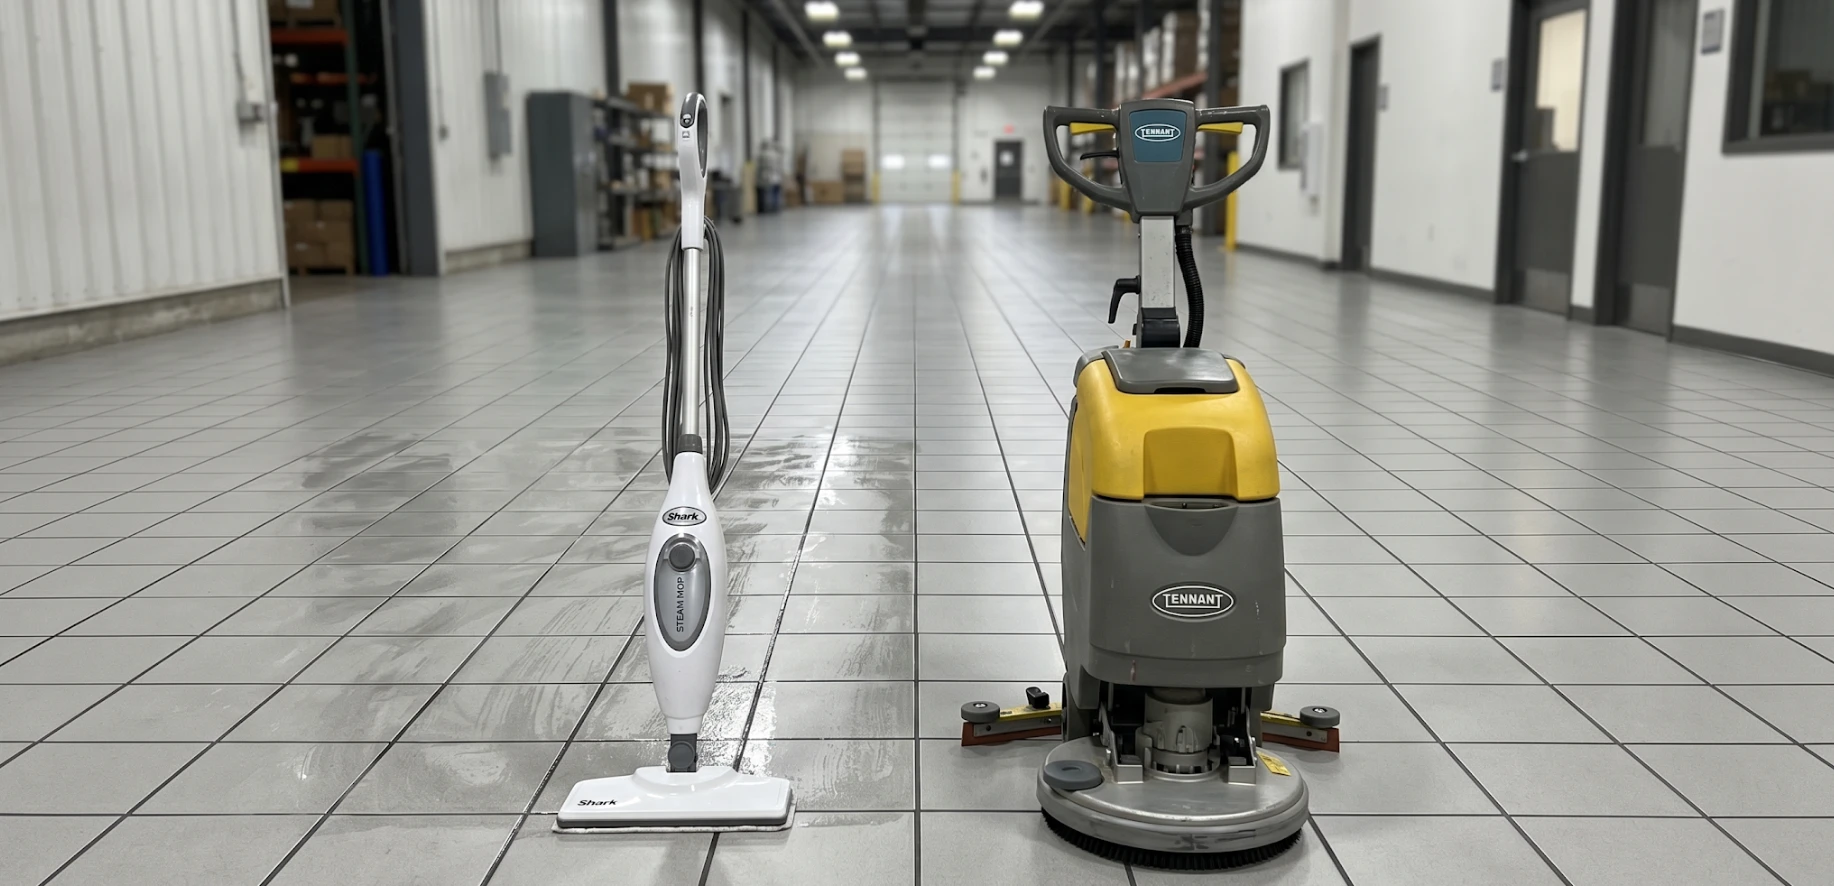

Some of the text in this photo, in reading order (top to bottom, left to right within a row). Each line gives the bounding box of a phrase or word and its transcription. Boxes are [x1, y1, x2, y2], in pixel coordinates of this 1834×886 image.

[1141, 128, 1175, 137] TENNANT
[667, 512, 699, 521] Shark
[676, 577, 685, 632] STEAM MOP
[1163, 593, 1223, 608] TENNANT
